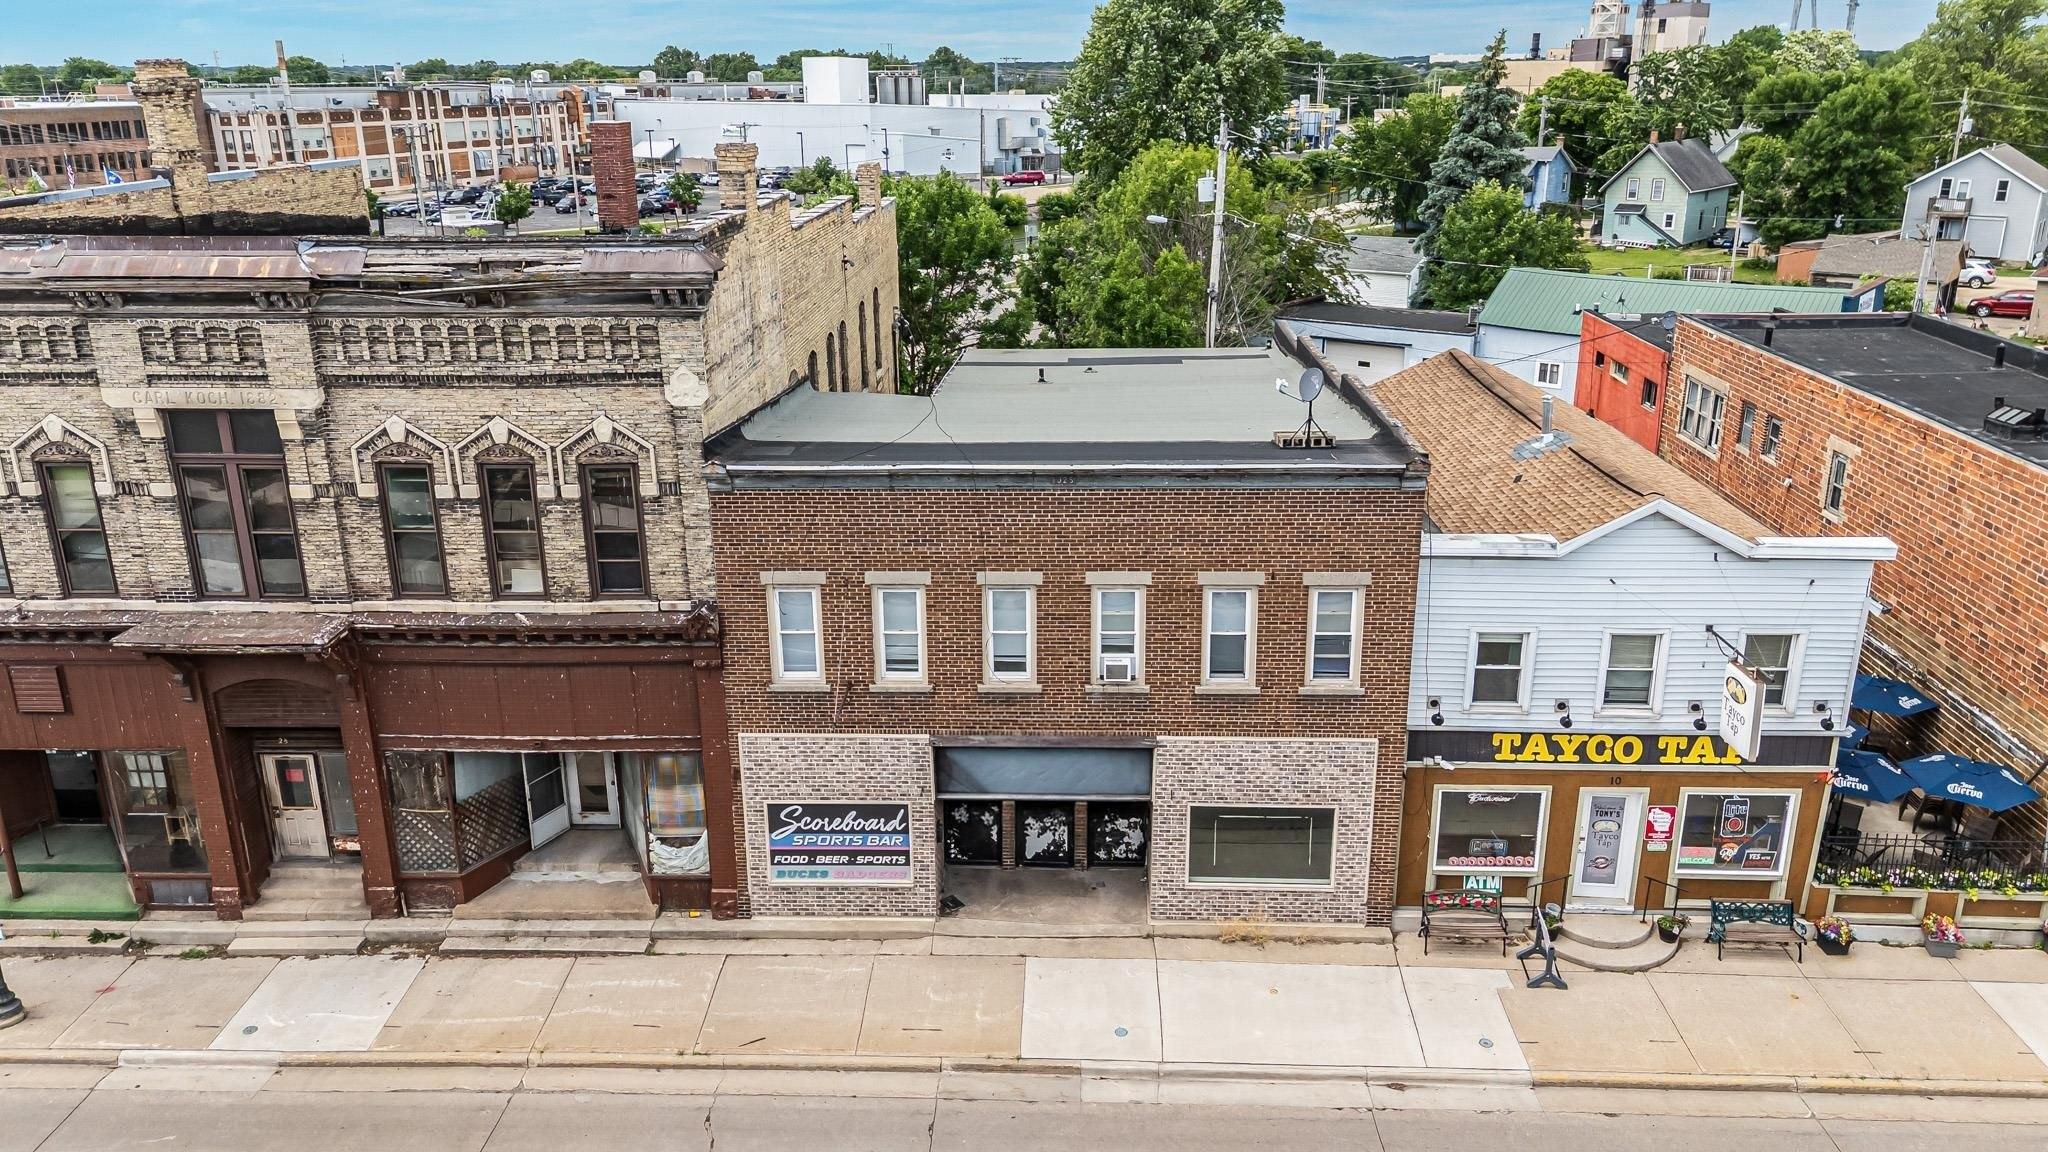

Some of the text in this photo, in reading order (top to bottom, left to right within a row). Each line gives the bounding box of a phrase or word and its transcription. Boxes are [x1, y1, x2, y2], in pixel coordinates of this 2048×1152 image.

[132, 390, 177, 405] CARL
[1724, 695, 1746, 726] Tayco
[1726, 713, 1739, 736] Tap
[1492, 733, 1644, 764] TAYCO
[1610, 776, 1622, 785] 10
[1834, 776, 1869, 792] Cuervo
[1946, 783, 1984, 799] Cuervo
[1595, 810, 1621, 818] TONY'S
[771, 805, 908, 840] Scoreboard
[792, 835, 904, 847] SPORTS BAR
[1592, 832, 1619, 840] Tayco
[1596, 840, 1612, 848] Tap
[773, 855, 906, 865] FOOD BEER SPORTS
[1466, 875, 1500, 889] ATM
